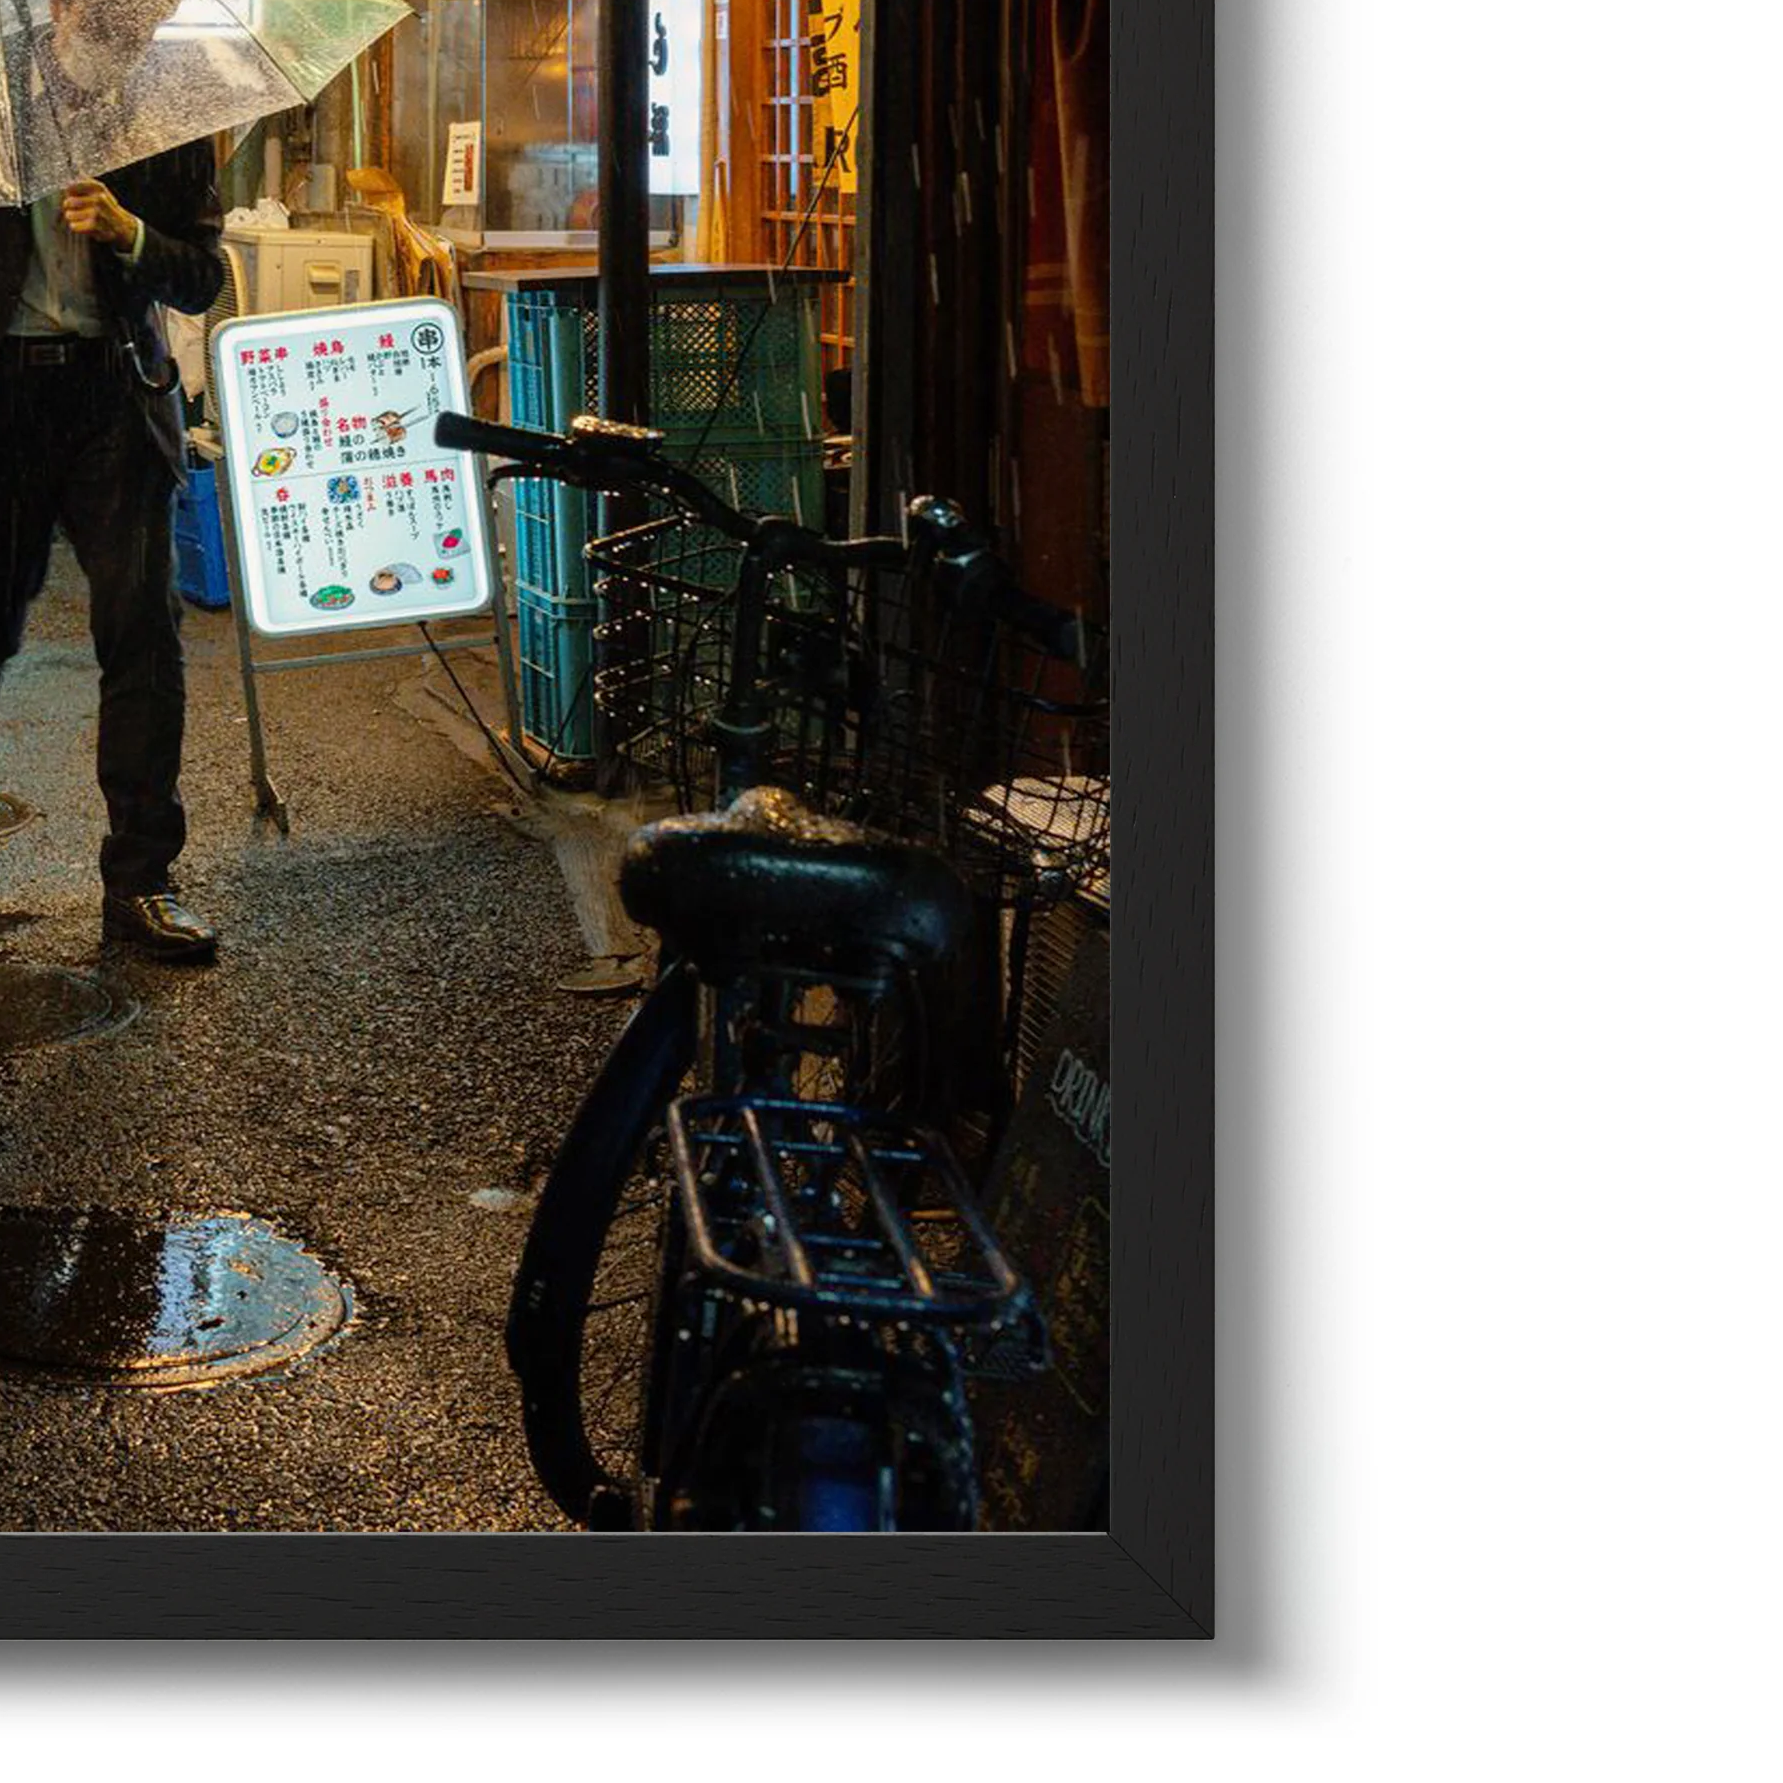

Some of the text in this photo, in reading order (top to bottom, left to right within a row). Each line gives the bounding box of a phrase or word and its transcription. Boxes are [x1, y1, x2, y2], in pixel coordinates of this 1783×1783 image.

[417, 328, 440, 351] 串
[240, 346, 289, 365] 野菜串
[336, 414, 367, 432] 名物
[382, 472, 413, 489] 滋養
[424, 468, 456, 483] 馬肉
